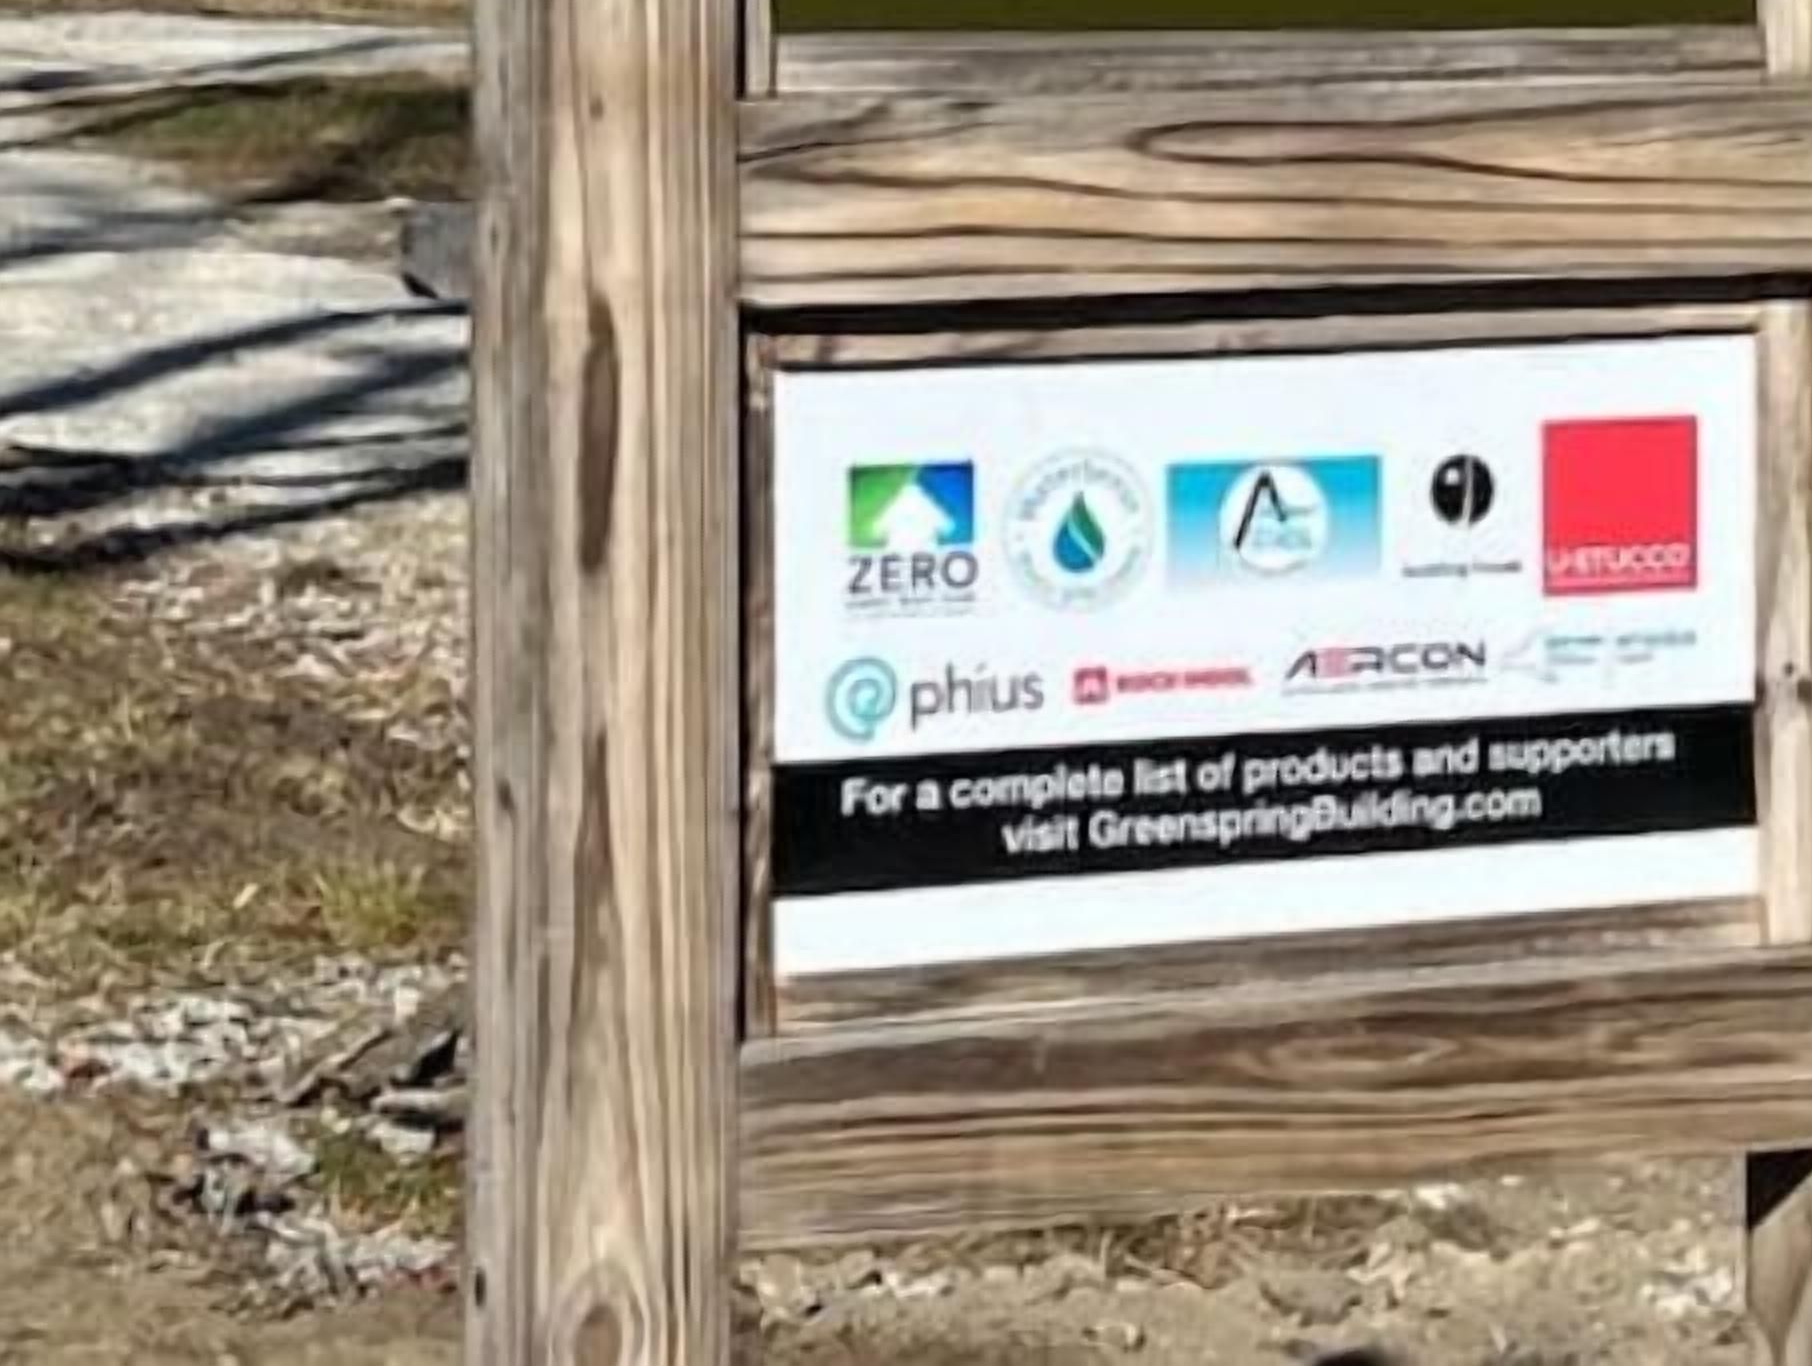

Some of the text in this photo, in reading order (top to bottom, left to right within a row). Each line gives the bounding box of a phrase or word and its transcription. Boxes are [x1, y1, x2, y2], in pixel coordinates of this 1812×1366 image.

[847, 551, 979, 594] ZERO
[911, 662, 1044, 731] phius
[841, 730, 1677, 817] For a complete list of products and supporters
[1001, 787, 1542, 854] visit GreenspringBuilding.com
